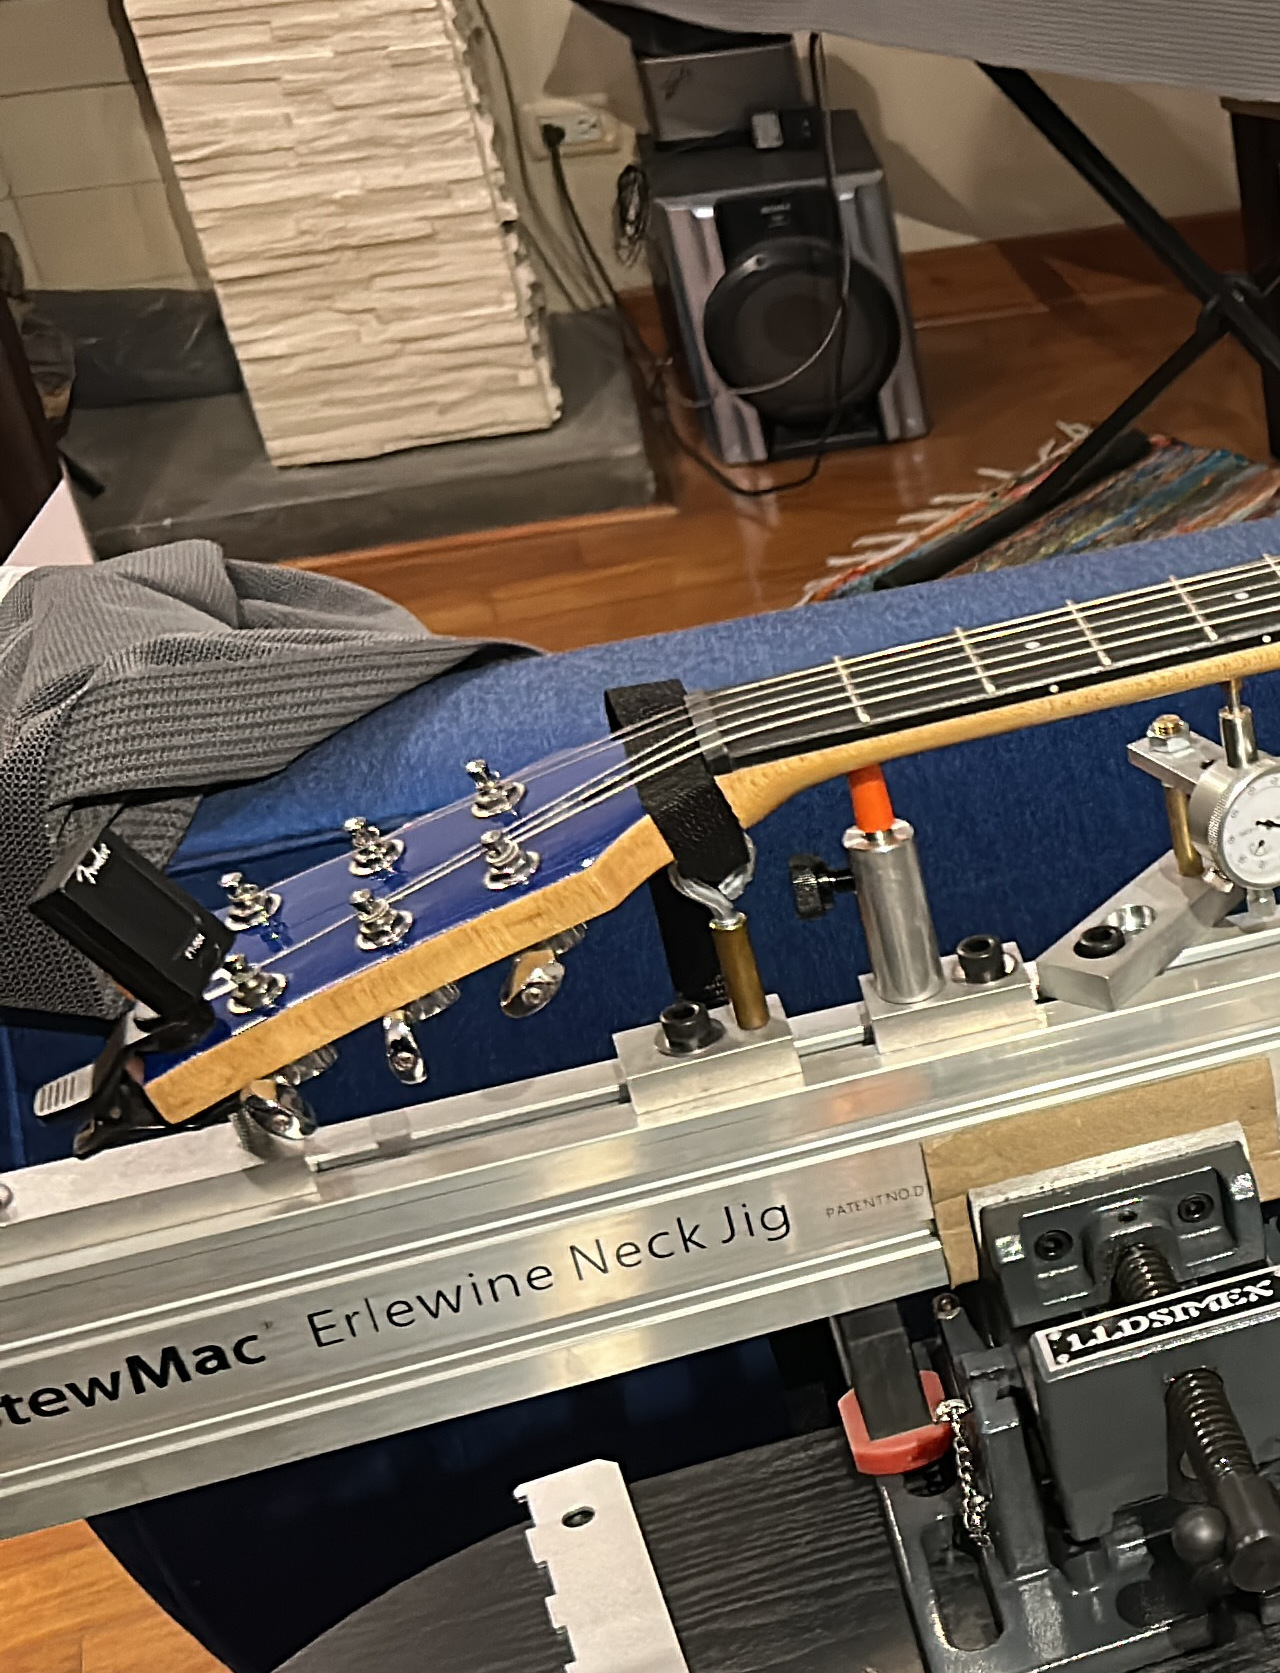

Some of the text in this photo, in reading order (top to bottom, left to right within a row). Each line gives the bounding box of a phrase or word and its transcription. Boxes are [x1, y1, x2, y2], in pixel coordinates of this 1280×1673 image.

[825, 1194, 883, 1218] PATENT
[0, 1203, 793, 1427] tewMac Erlewine Neck Jig
